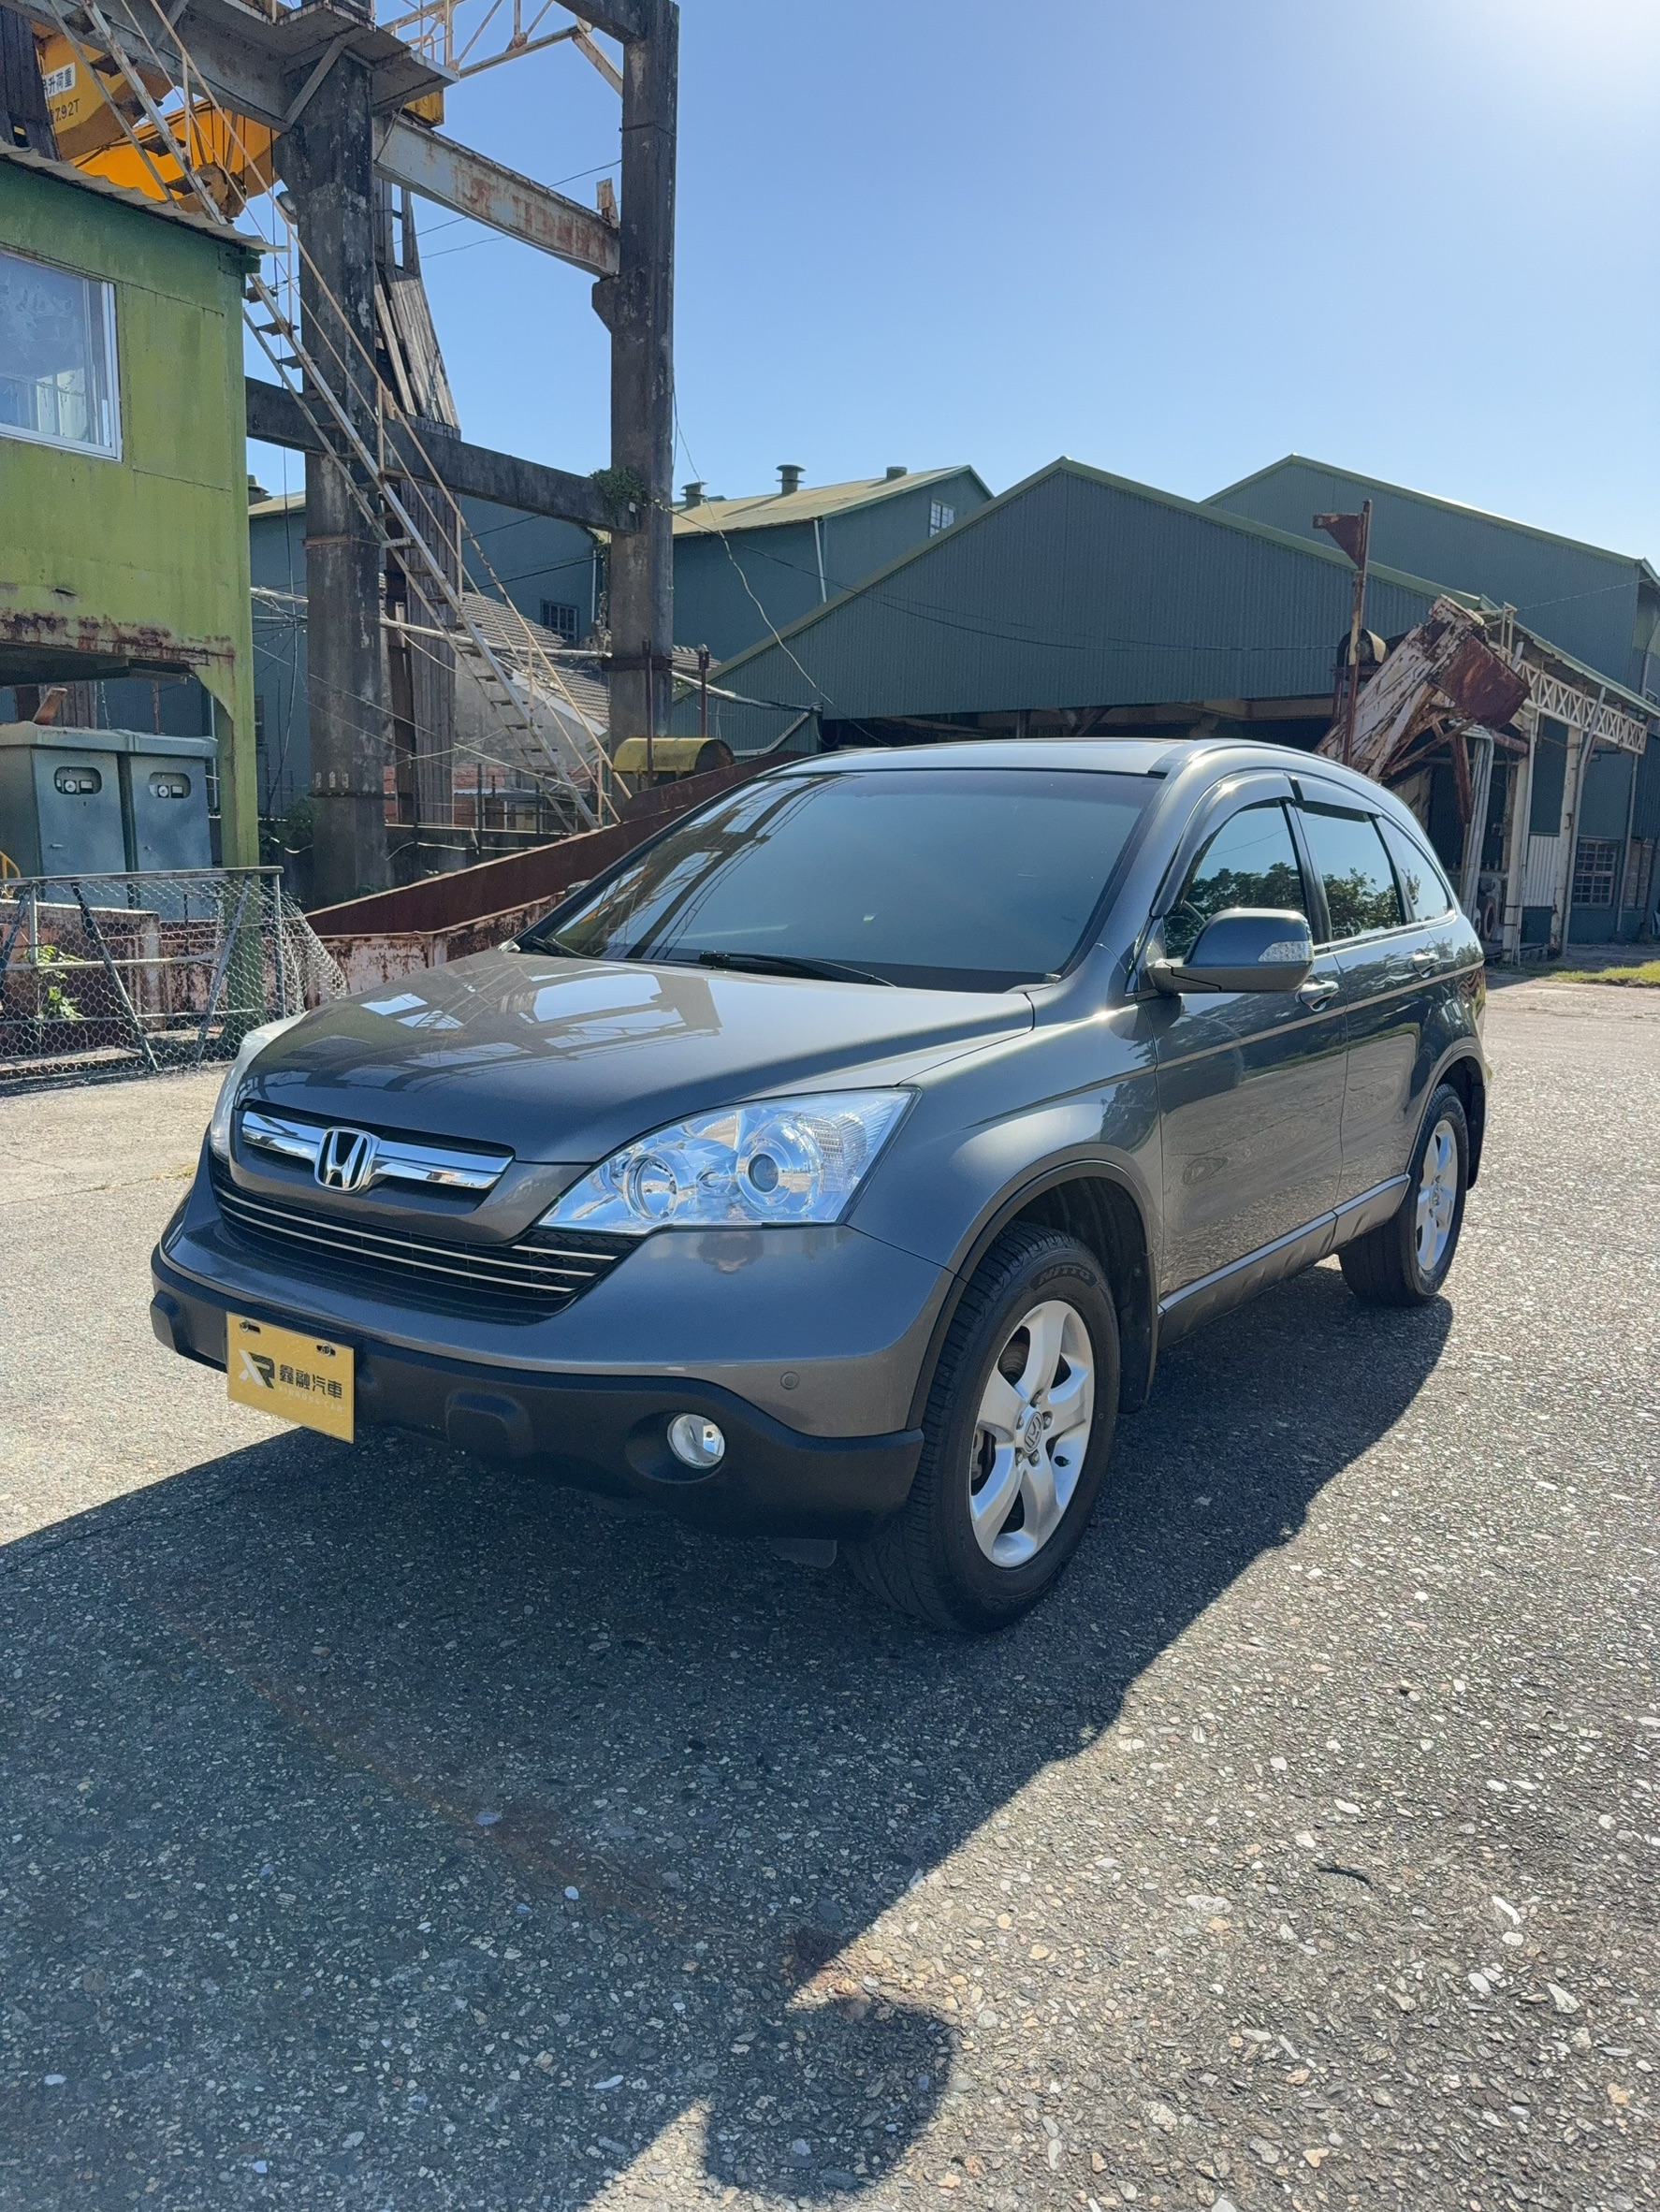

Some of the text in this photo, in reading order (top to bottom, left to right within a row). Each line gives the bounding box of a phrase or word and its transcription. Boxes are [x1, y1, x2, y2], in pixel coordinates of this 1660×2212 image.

[1038, 1264, 1092, 1286] NITTO
[279, 1363, 343, 1400] 鑫融汽車
